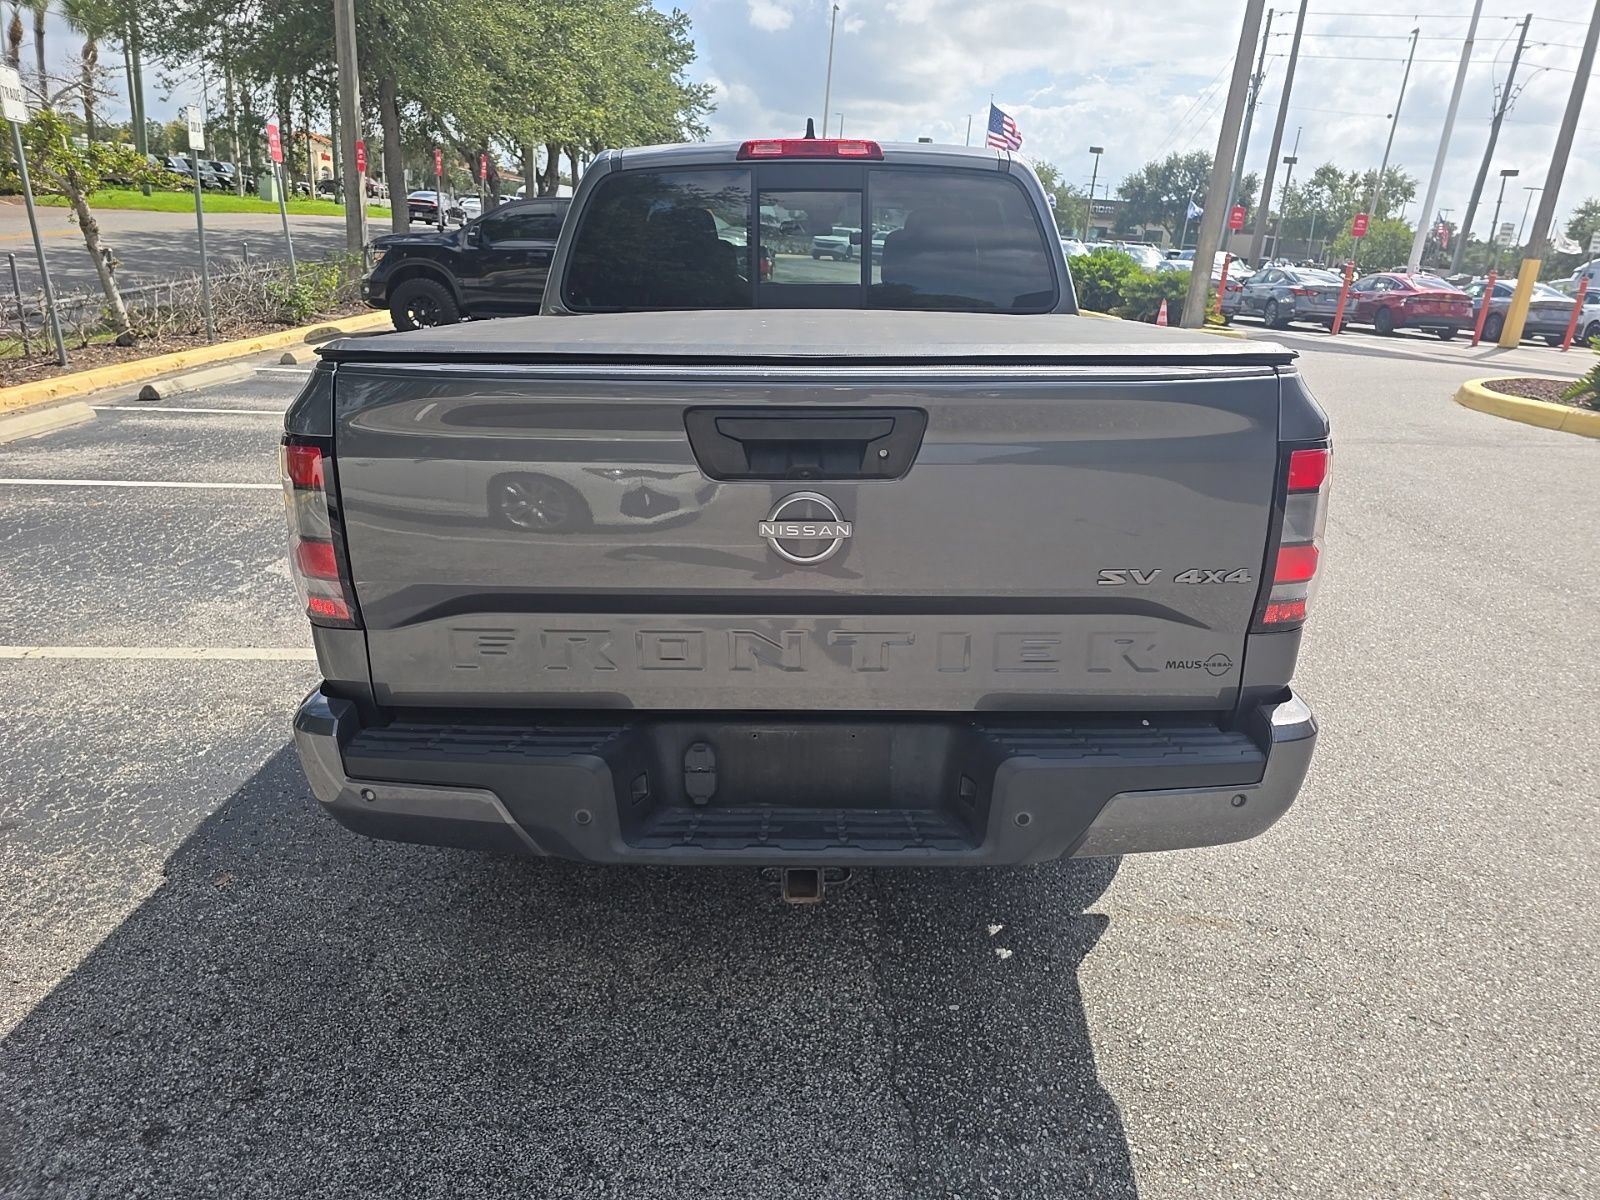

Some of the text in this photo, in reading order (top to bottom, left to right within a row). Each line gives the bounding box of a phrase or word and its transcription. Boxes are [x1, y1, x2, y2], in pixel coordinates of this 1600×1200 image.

[0, 85, 22, 102] TRADE
[761, 524, 850, 536] NISSAN
[1097, 568, 1162, 585] SV
[449, 627, 1160, 673] FRONTIER
[1165, 660, 1202, 670] MAUS
